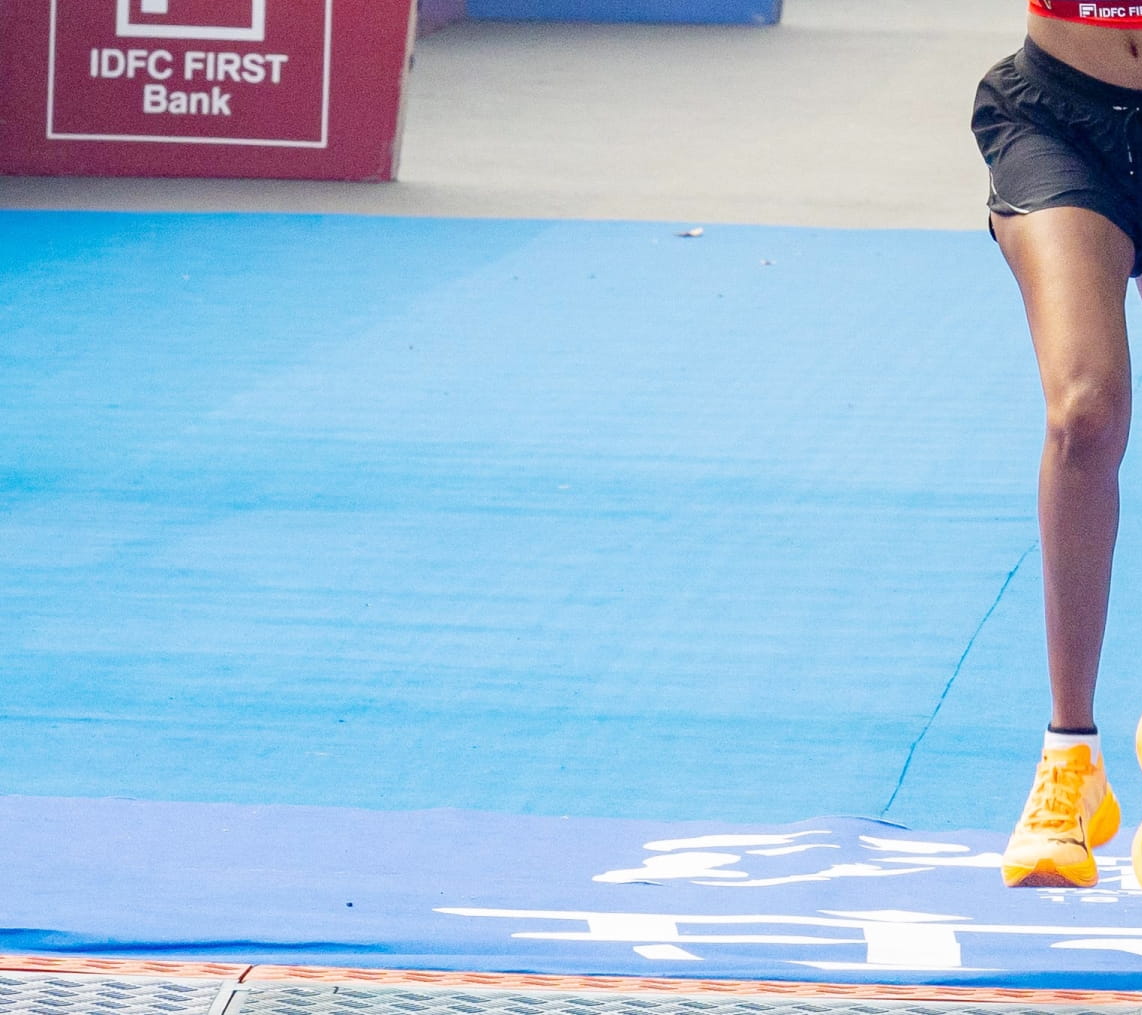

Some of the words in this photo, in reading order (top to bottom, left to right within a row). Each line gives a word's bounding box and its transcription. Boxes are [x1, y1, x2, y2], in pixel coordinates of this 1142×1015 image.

[1098, 7, 1126, 18] IDFC
[90, 48, 173, 80] IDFC
[184, 52, 289, 85] FIRST
[143, 84, 231, 116] Bank
